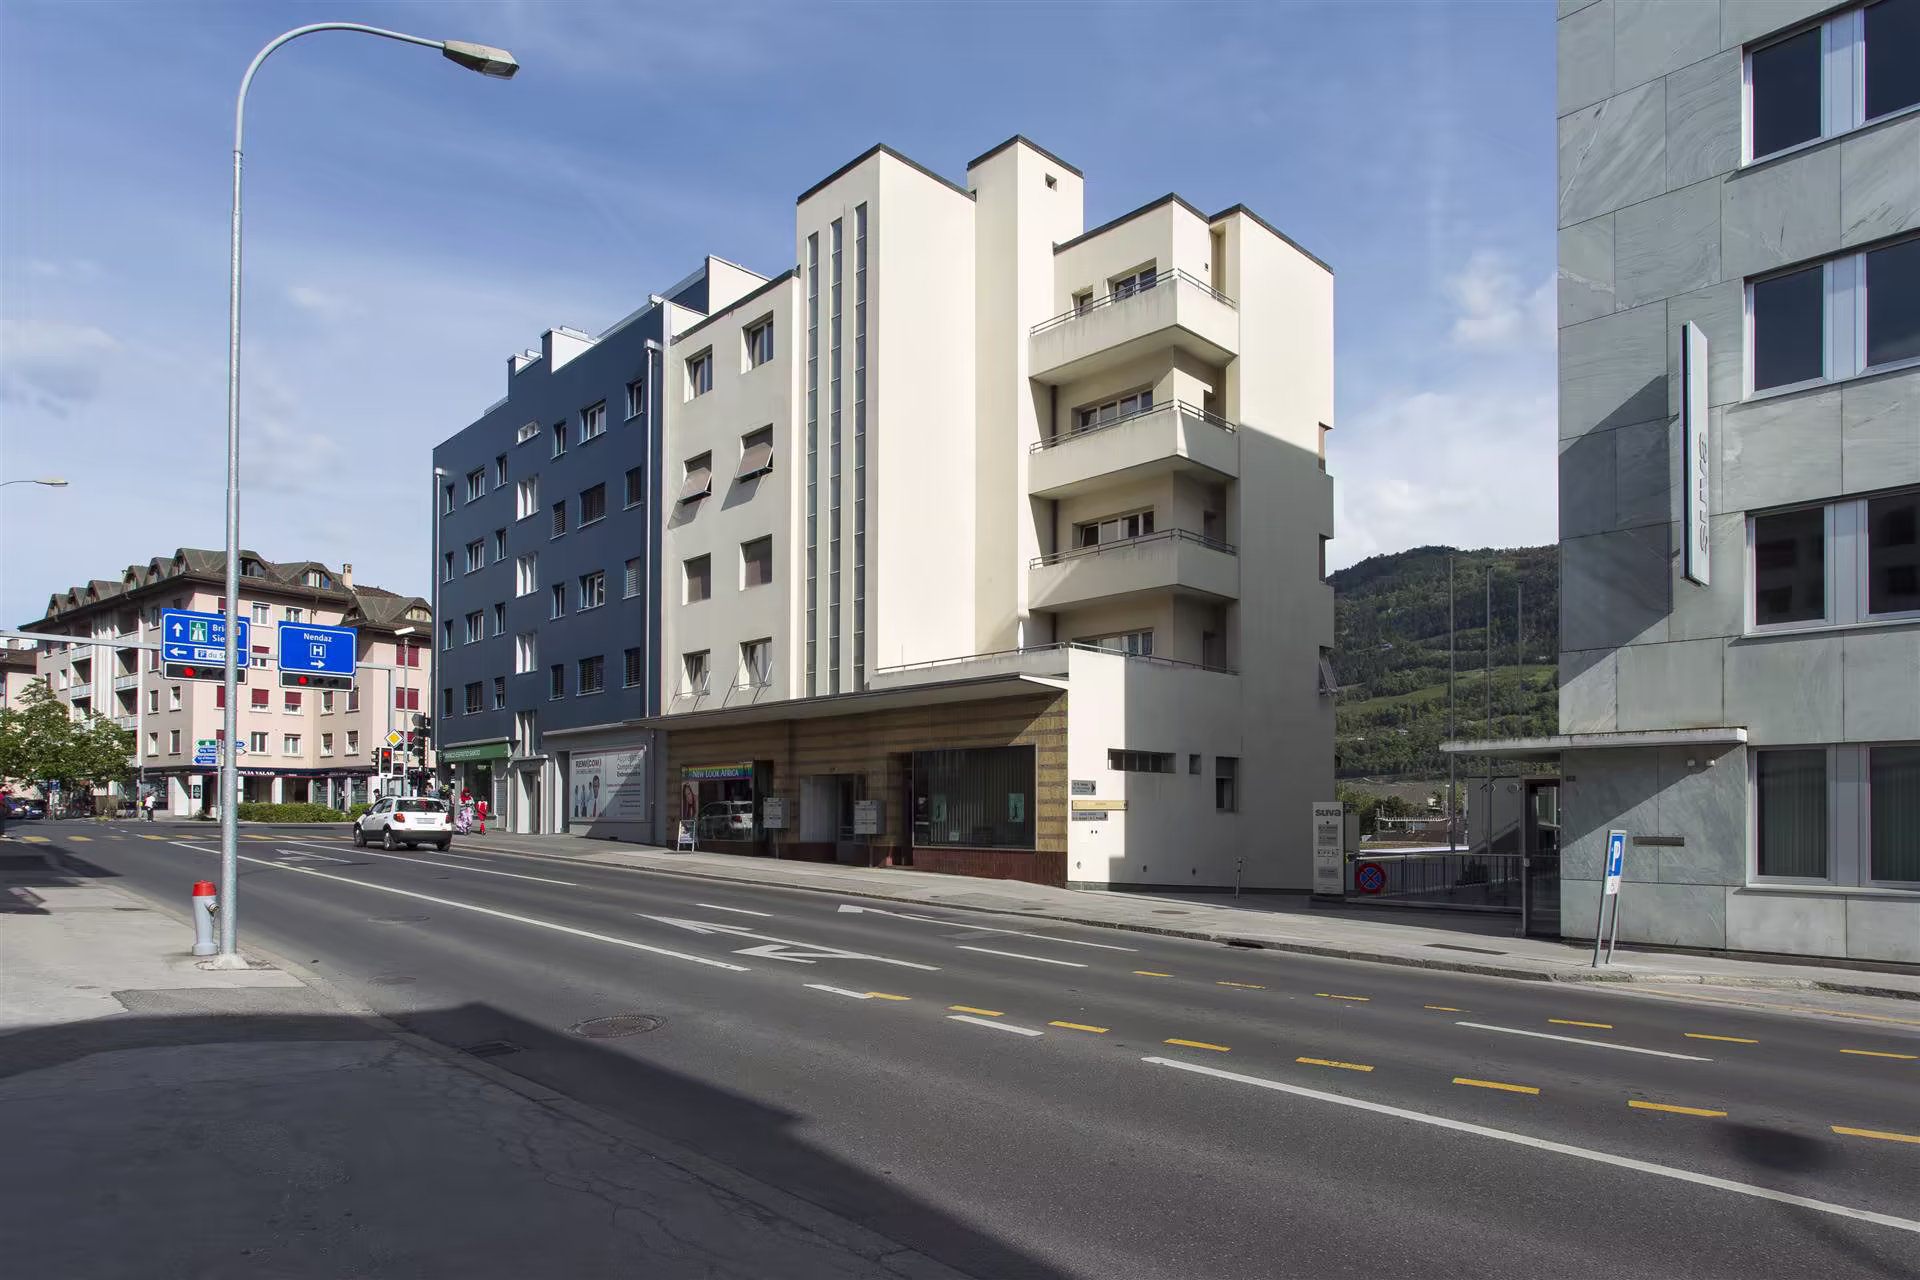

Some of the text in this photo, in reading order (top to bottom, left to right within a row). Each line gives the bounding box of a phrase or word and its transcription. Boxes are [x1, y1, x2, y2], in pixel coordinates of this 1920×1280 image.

[212, 624, 225, 632] Bri
[212, 634, 226, 643] Sie
[303, 632, 332, 643] Nendaz
[1315, 808, 1342, 817] suva
[1611, 840, 1621, 872] P
